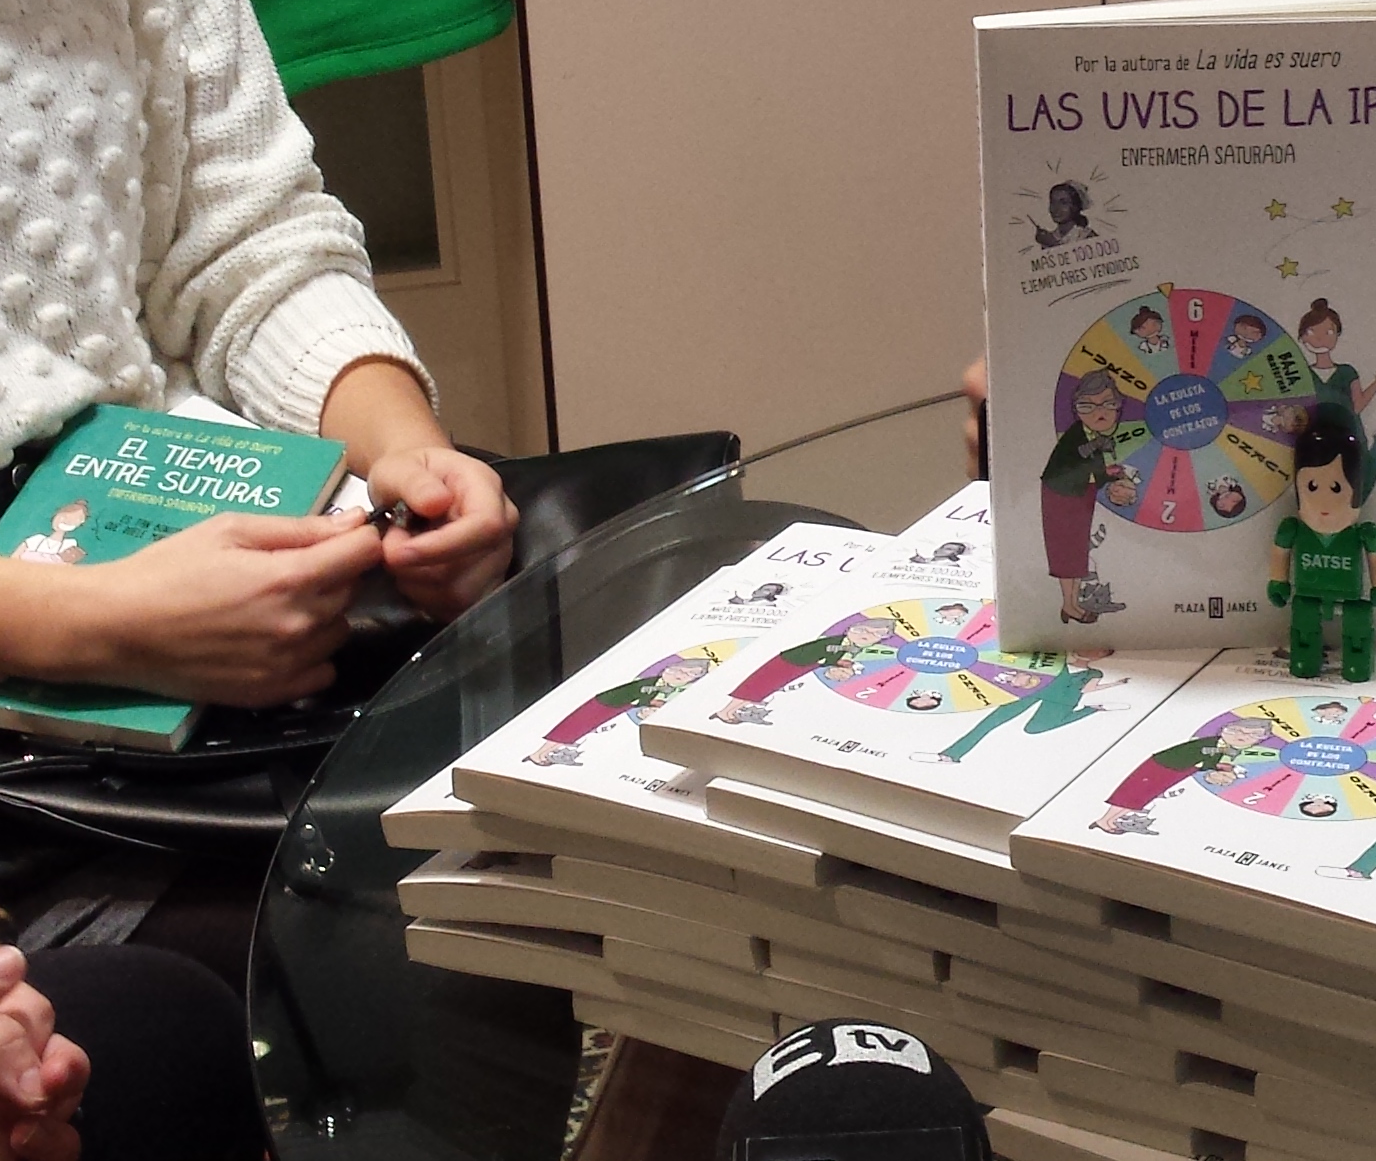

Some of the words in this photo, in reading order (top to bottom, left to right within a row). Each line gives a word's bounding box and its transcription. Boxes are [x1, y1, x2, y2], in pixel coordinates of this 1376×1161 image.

[1075, 56, 1099, 72] Por
[1105, 55, 1117, 72] la
[1122, 54, 1171, 72] autora
[1176, 54, 1190, 71] de
[1196, 49, 1216, 70] La
[1225, 49, 1258, 70] vida
[1264, 51, 1284, 69] es
[1289, 50, 1341, 69] suero
[1008, 92, 1083, 132] LAS
[1102, 90, 1199, 130] UVIS
[1218, 89, 1265, 128] DE
[1284, 88, 1333, 127] LA
[1121, 144, 1209, 167] ENFERMERA
[1214, 143, 1296, 165] SATURADA
[1058, 251, 1071, 267] DE
[1020, 267, 1088, 295] EJEMPLARES
[1089, 255, 1140, 279] VENDIDOS
[1187, 298, 1205, 322] 6
[1080, 346, 1148, 391] TURNO
[117, 437, 149, 461] EL
[164, 444, 262, 479] TIEMPO
[1227, 433, 1291, 481] TURNO
[65, 454, 156, 488] ENTRE
[158, 471, 282, 508] SUTURAS
[946, 505, 991, 525] LA
[767, 546, 832, 567] LAS
[1301, 553, 1351, 570] SATSE
[1174, 603, 1205, 613] PLAZA
[1203, 844, 1237, 859] PLAZA
